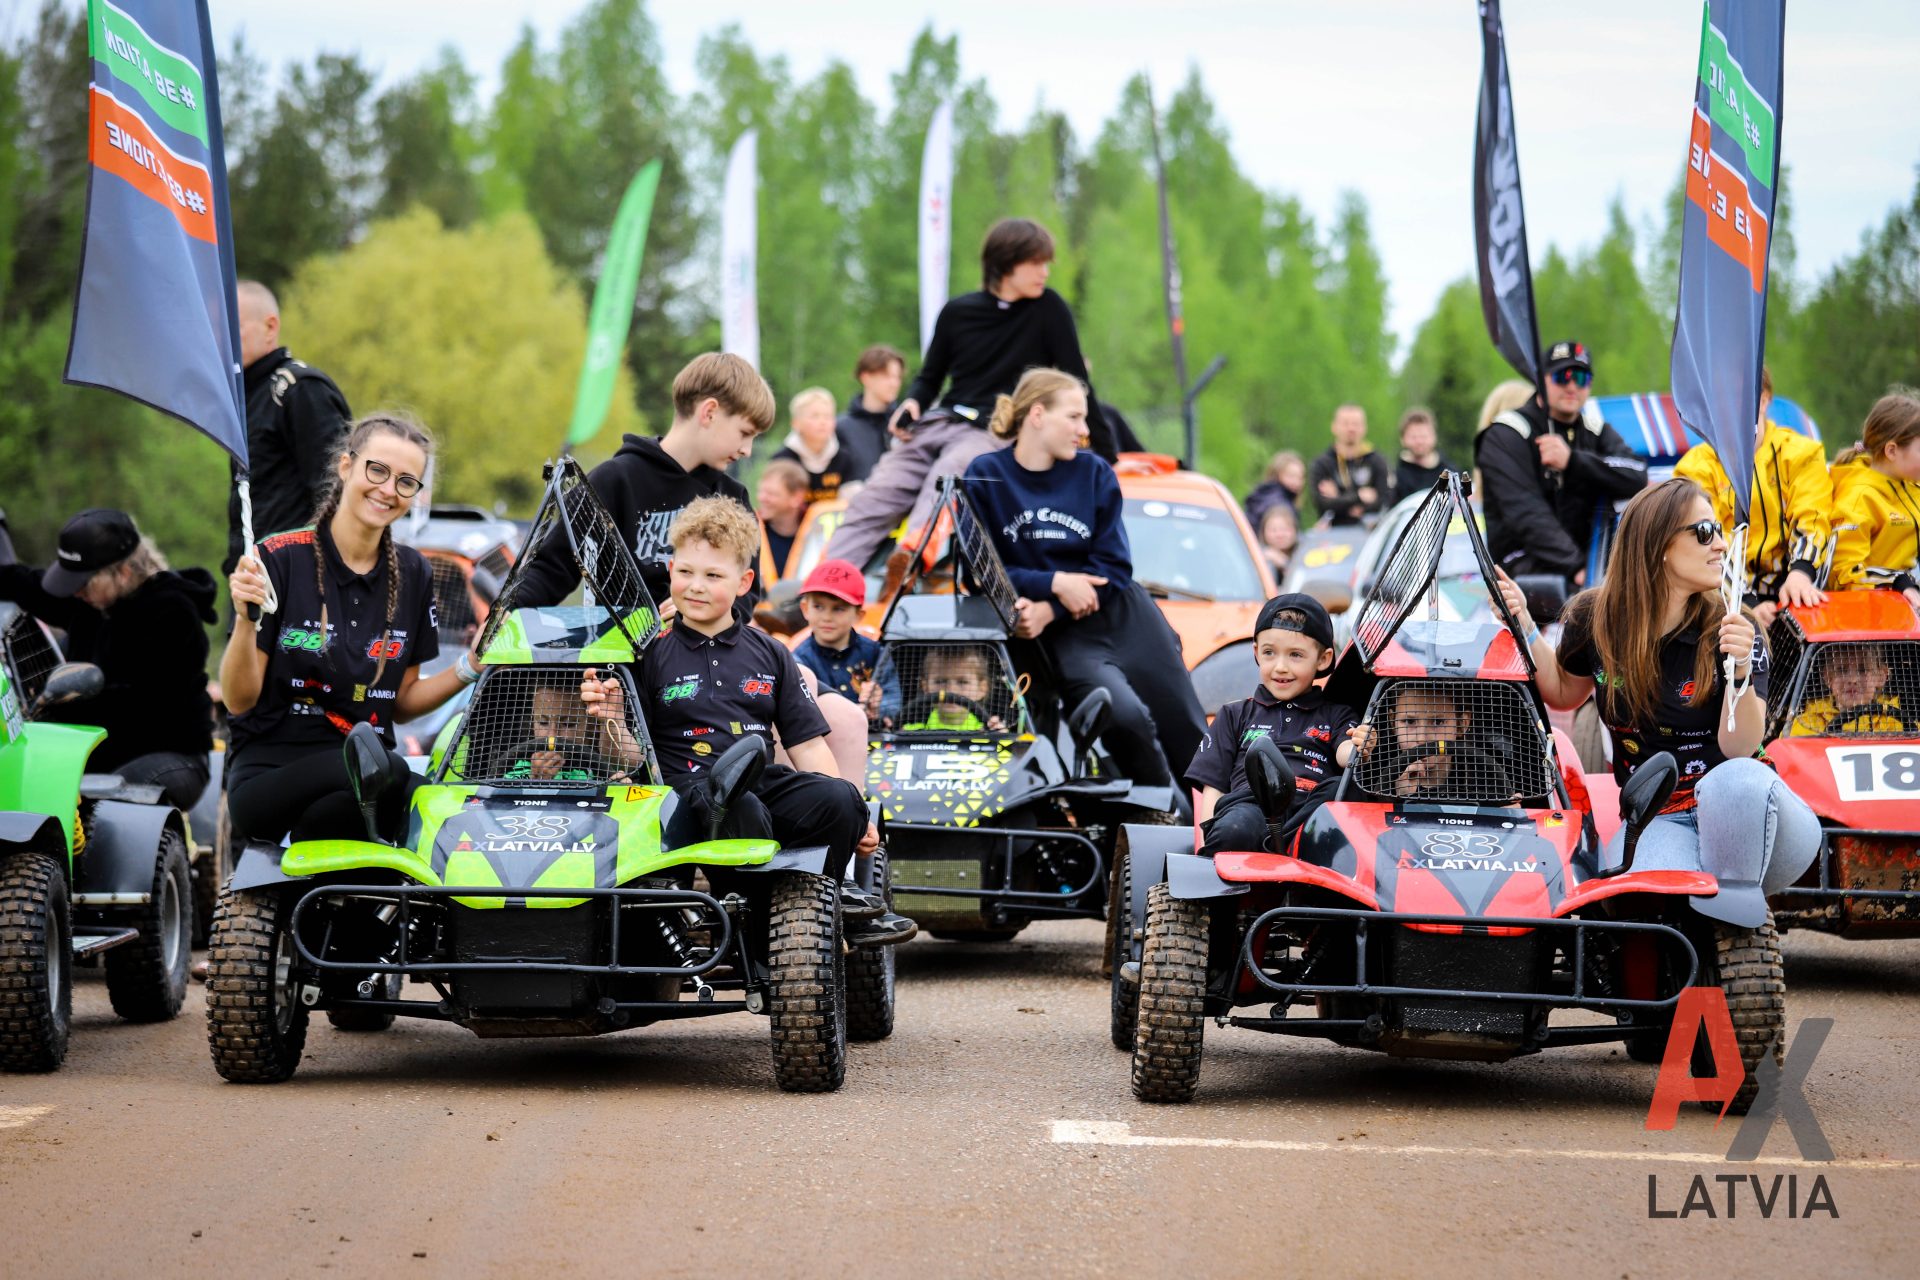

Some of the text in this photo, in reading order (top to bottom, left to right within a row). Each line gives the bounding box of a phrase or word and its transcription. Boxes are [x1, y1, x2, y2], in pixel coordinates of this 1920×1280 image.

[1037, 507, 1091, 539] Couture
[281, 630, 327, 650] 38
[663, 682, 697, 700] 38
[743, 680, 773, 695] 83
[886, 754, 990, 780] 15
[1841, 752, 1920, 792] 18
[485, 815, 572, 840] 38
[1438, 818, 1474, 826] TIONE
[456, 840, 598, 853] AXLATVIA.LV
[1421, 831, 1504, 858] 83
[1396, 858, 1538, 872] AXLATVIA.LV
